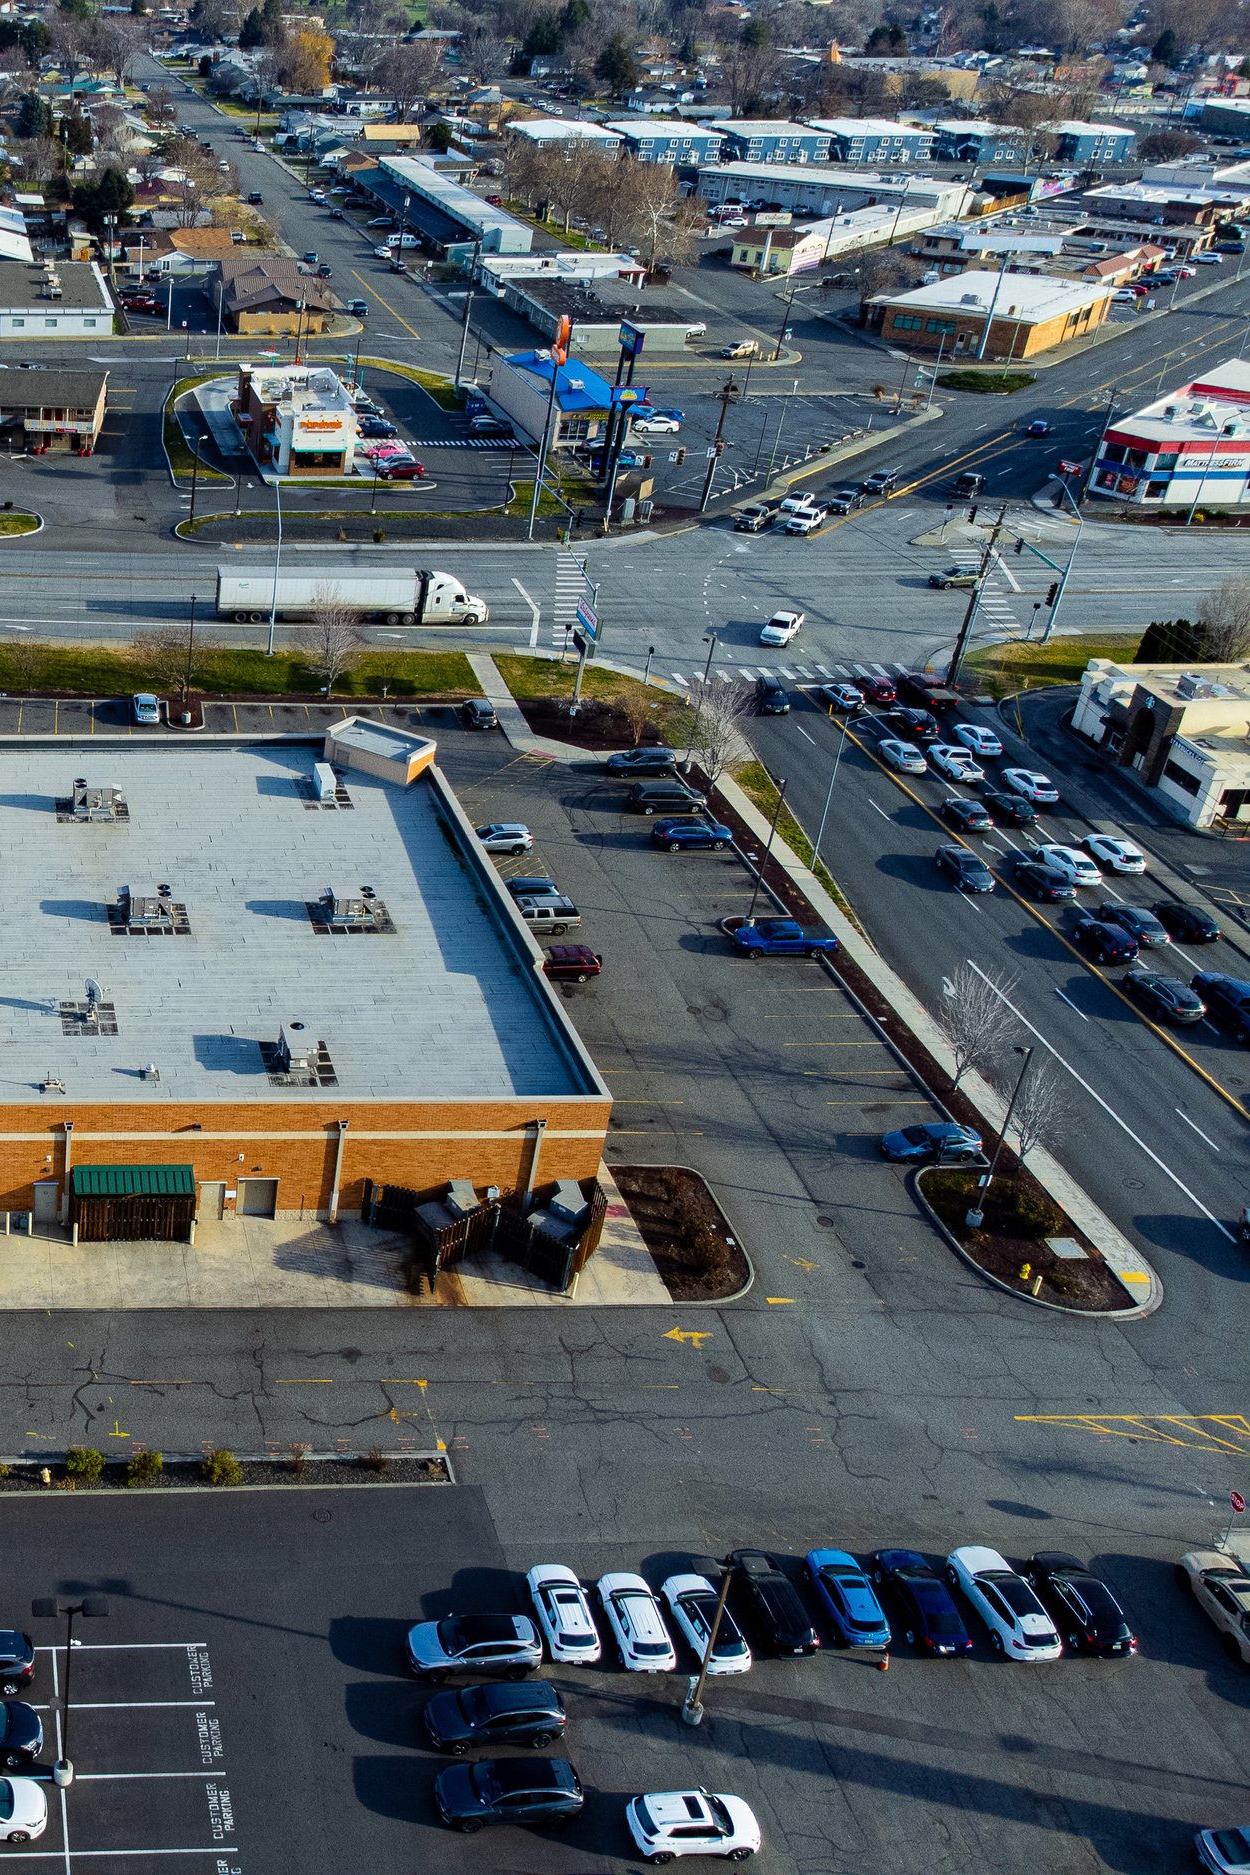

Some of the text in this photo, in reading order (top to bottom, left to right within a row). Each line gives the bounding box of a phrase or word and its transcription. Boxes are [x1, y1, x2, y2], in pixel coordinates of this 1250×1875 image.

[1231, 1493, 1245, 1509] STOP
[187, 1645, 203, 1694] CUSTOMER
[199, 1652, 213, 1688] PARKING
[196, 1712, 212, 1764] CUSTOMER
[208, 1718, 224, 1757] PARKING
[206, 1782, 224, 1839] CUSTOMER
[219, 1790, 235, 1831] PARKING
